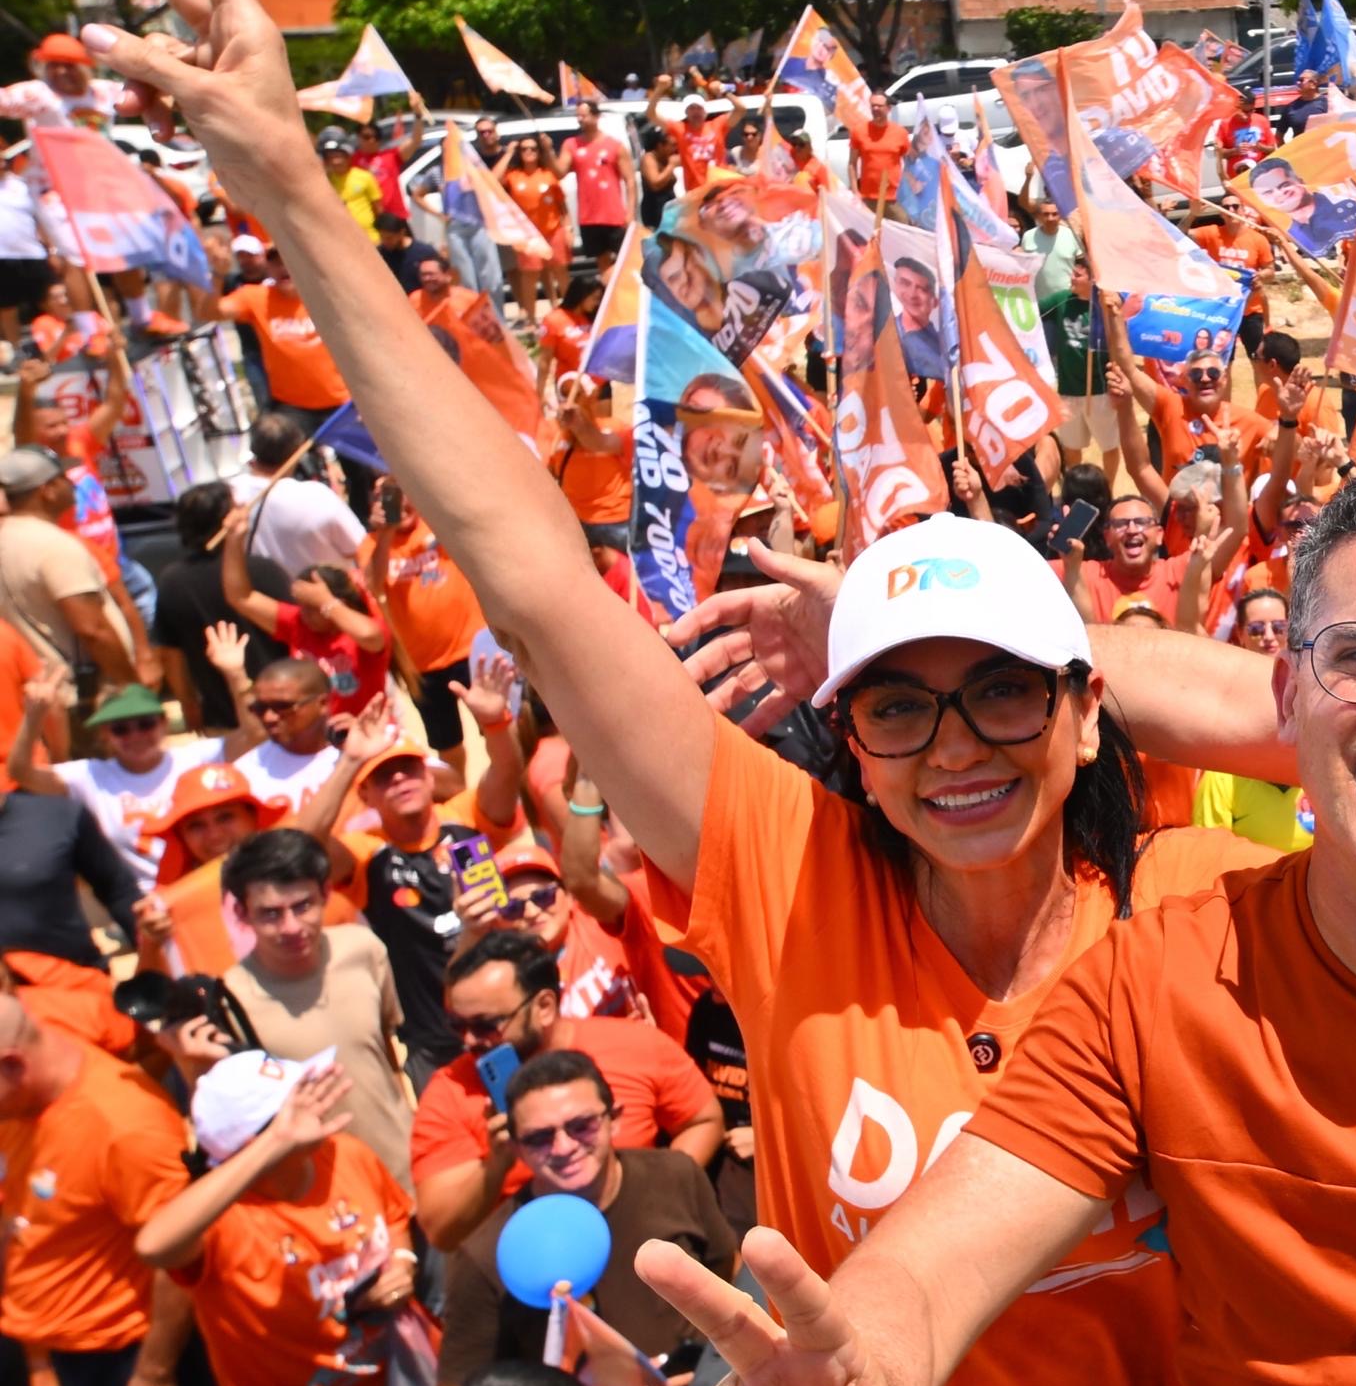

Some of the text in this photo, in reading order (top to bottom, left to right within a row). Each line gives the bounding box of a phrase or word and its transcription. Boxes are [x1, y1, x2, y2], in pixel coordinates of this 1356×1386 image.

[963, 330, 1050, 441] 70
[648, 417, 691, 494] 70
[887, 557, 981, 600] D70
